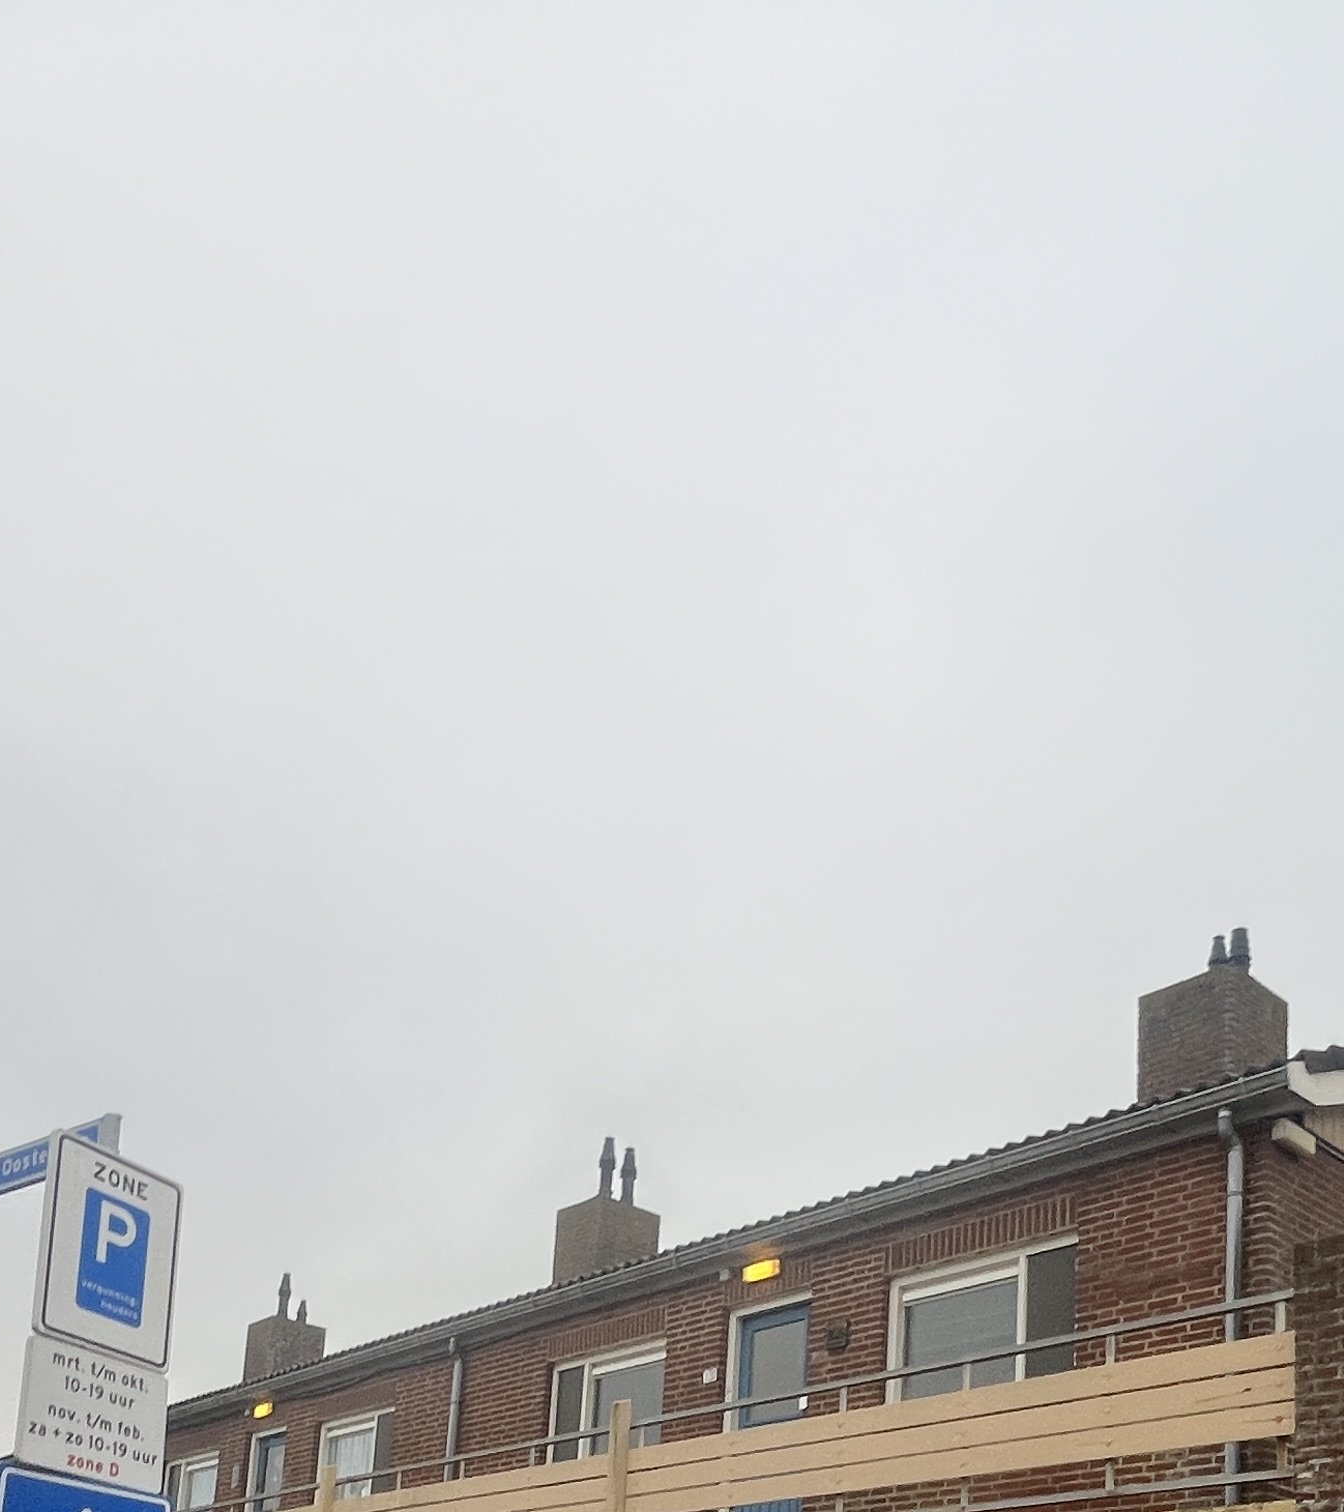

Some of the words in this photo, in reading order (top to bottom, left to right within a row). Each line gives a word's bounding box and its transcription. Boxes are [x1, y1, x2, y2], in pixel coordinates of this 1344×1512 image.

[2, 1149, 48, 1176] Ooste
[94, 1162, 148, 1200] ZONE
[96, 1200, 137, 1264] P
[53, 1352, 85, 1373] mrt.
[91, 1362, 116, 1383] t/m
[122, 1374, 149, 1394] okt.
[64, 1375, 104, 1400] 10-19
[110, 1391, 135, 1410] uur
[48, 1404, 80, 1424] nov.
[87, 1413, 112, 1433] t/m
[118, 1422, 145, 1442] feb.
[28, 1422, 47, 1437] za
[53, 1427, 61, 1438] +
[65, 1432, 83, 1446] zo
[89, 1435, 127, 1458] 10-19
[132, 1449, 158, 1466] uur
[67, 1454, 103, 1473] zone
[109, 1462, 119, 1477] D
